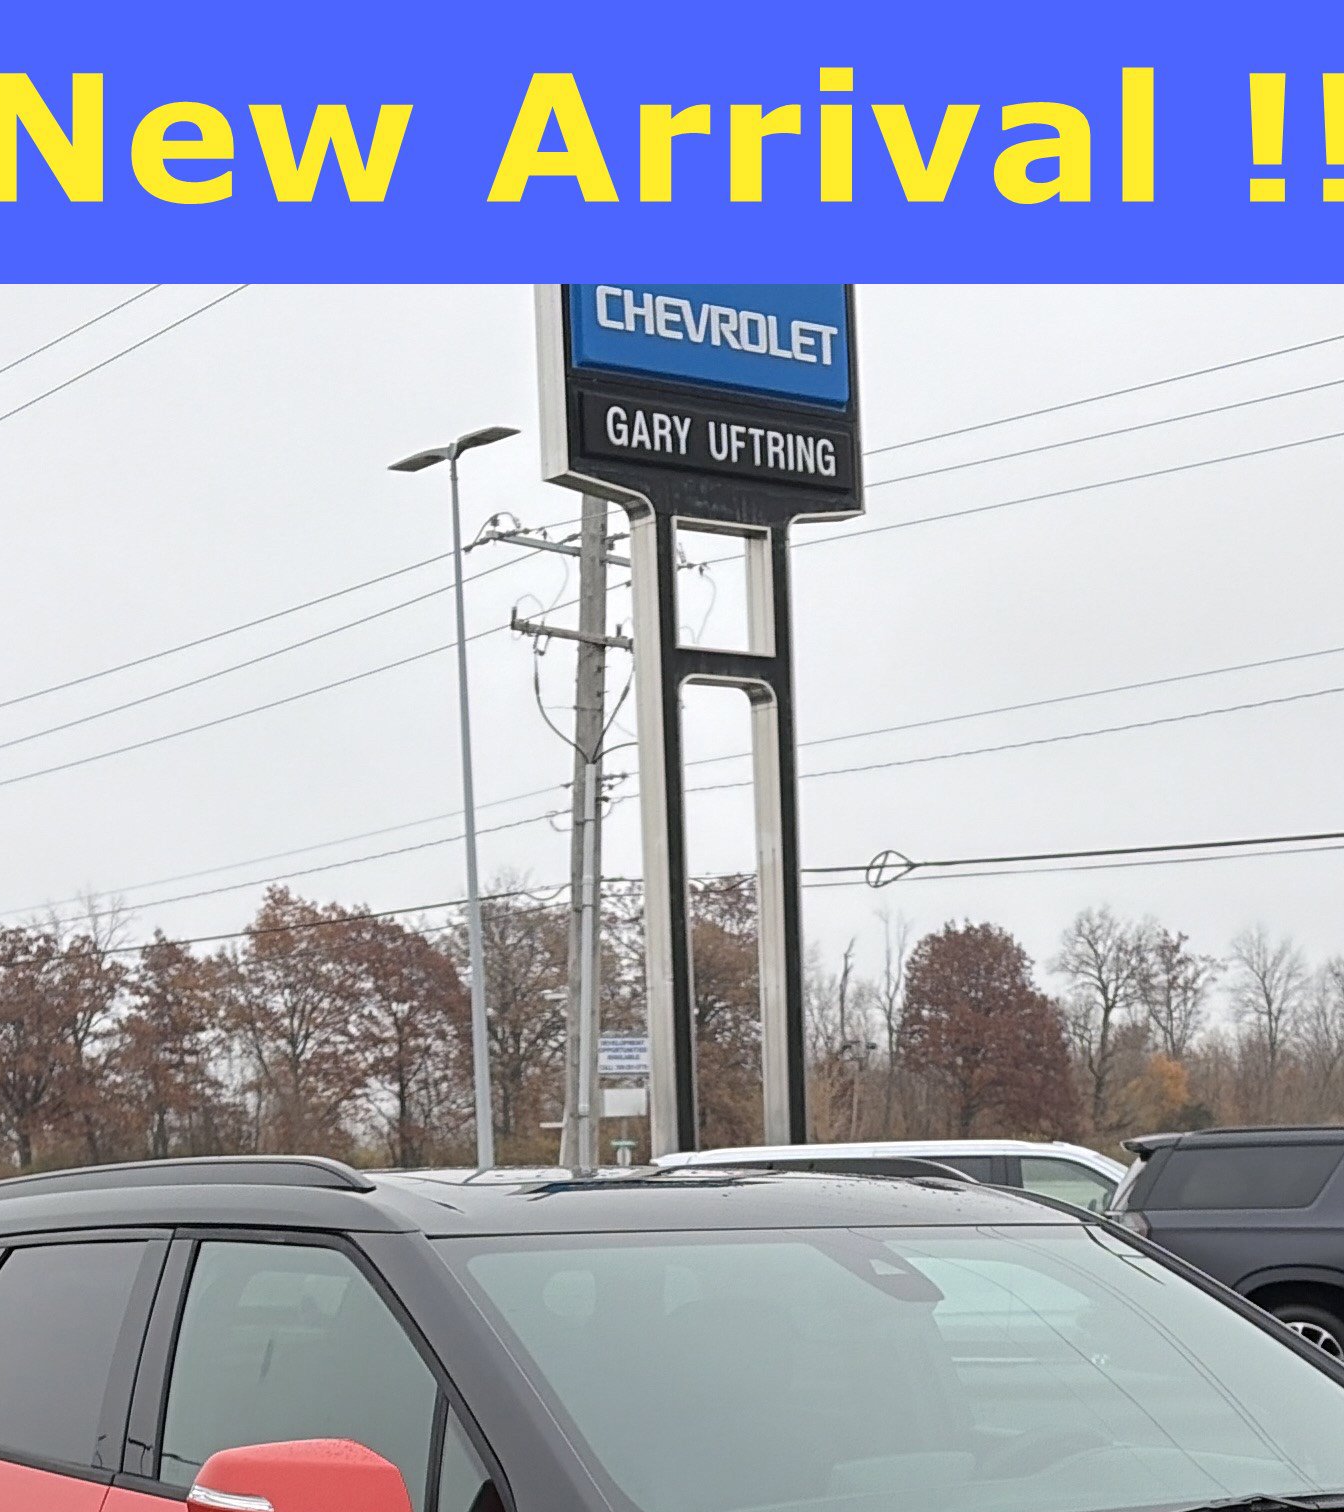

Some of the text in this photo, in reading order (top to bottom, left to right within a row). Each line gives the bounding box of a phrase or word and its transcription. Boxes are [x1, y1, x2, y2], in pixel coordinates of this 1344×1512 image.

[596, 285, 838, 365] CHEVROLET
[606, 406, 836, 477] GARY UFTRING
